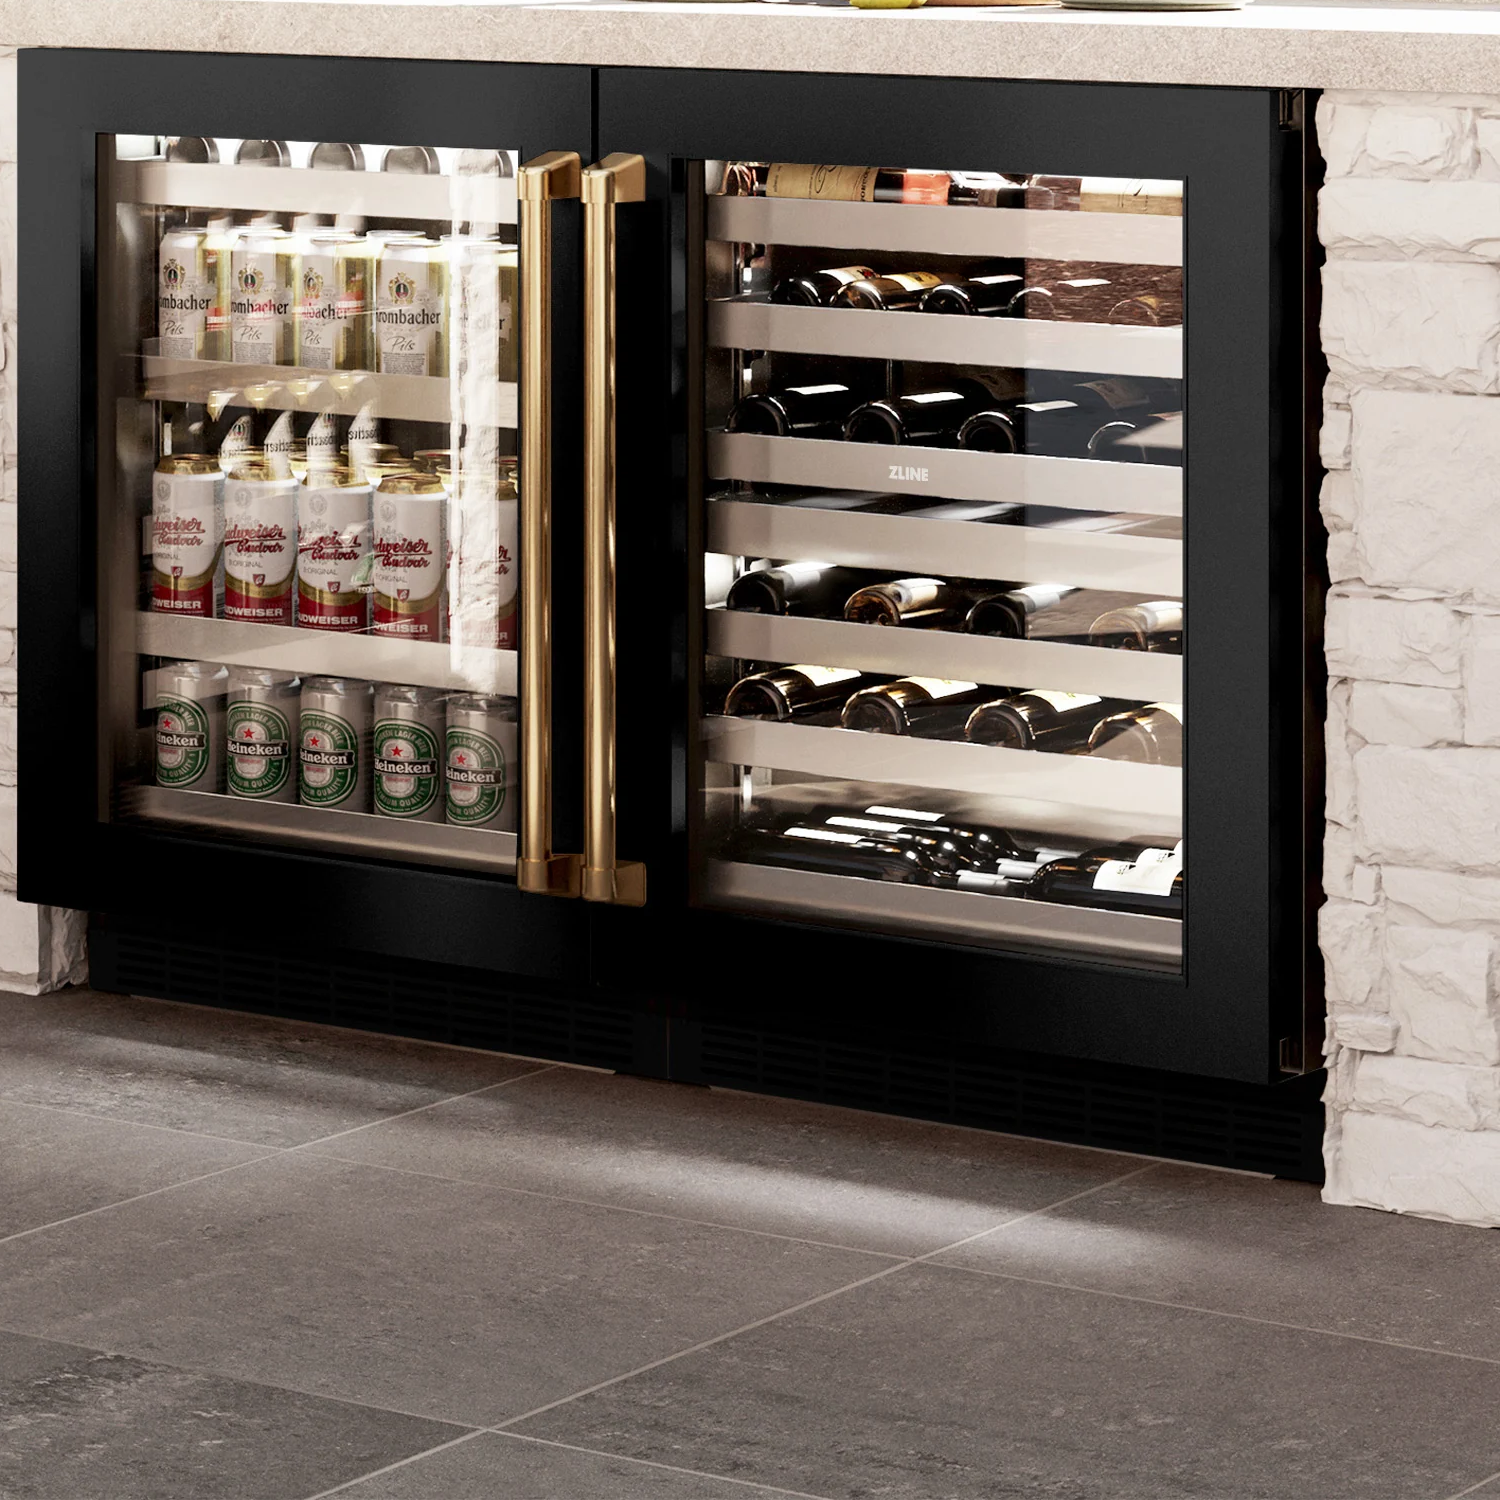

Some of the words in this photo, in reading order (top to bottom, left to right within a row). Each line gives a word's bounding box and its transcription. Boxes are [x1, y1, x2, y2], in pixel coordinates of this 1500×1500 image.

[385, 336, 416, 352] Pils
[889, 466, 929, 482] ZLINE
[312, 546, 359, 561] Budvar
[227, 741, 283, 756] Heineken
[374, 758, 431, 774] Heineken
